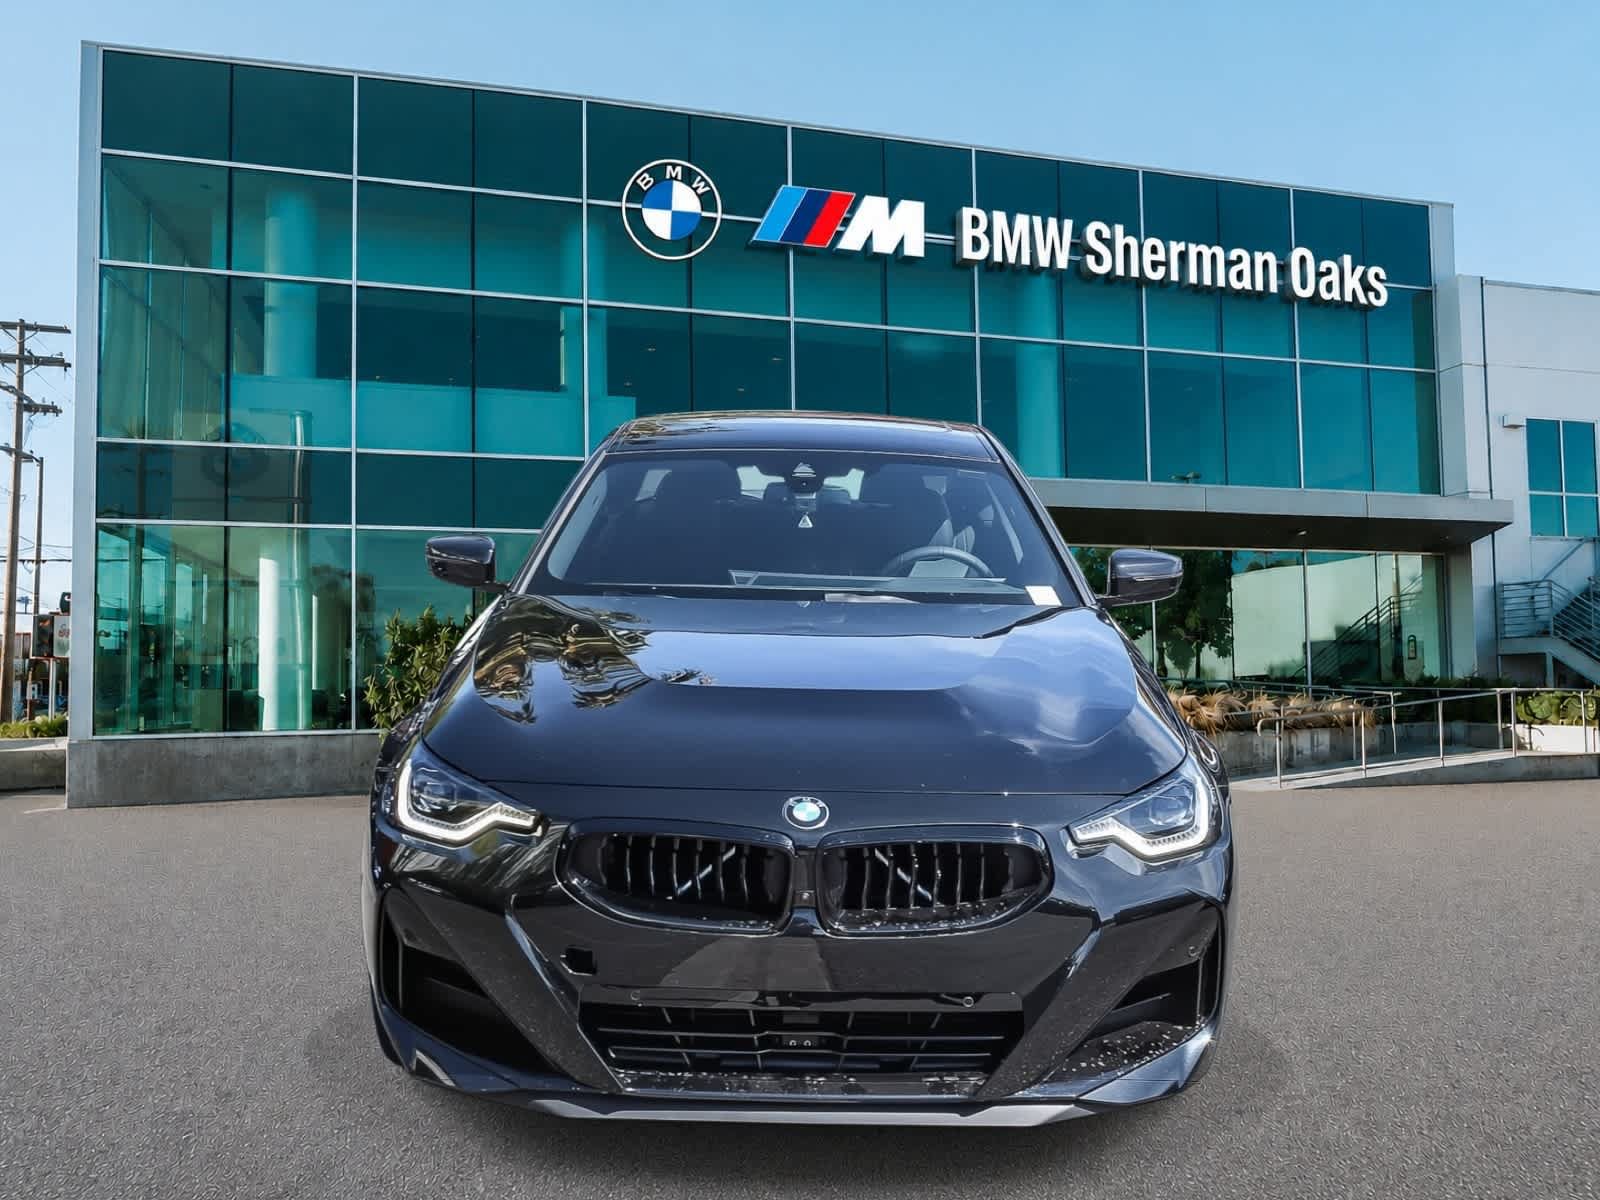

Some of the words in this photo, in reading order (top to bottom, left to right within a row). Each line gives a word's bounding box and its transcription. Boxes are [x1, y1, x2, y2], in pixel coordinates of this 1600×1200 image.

[636, 165, 711, 195] BMW
[834, 195, 925, 258] M
[961, 206, 1073, 269] BMW
[1084, 220, 1278, 294] Sherman
[1289, 247, 1388, 307] Oaks
